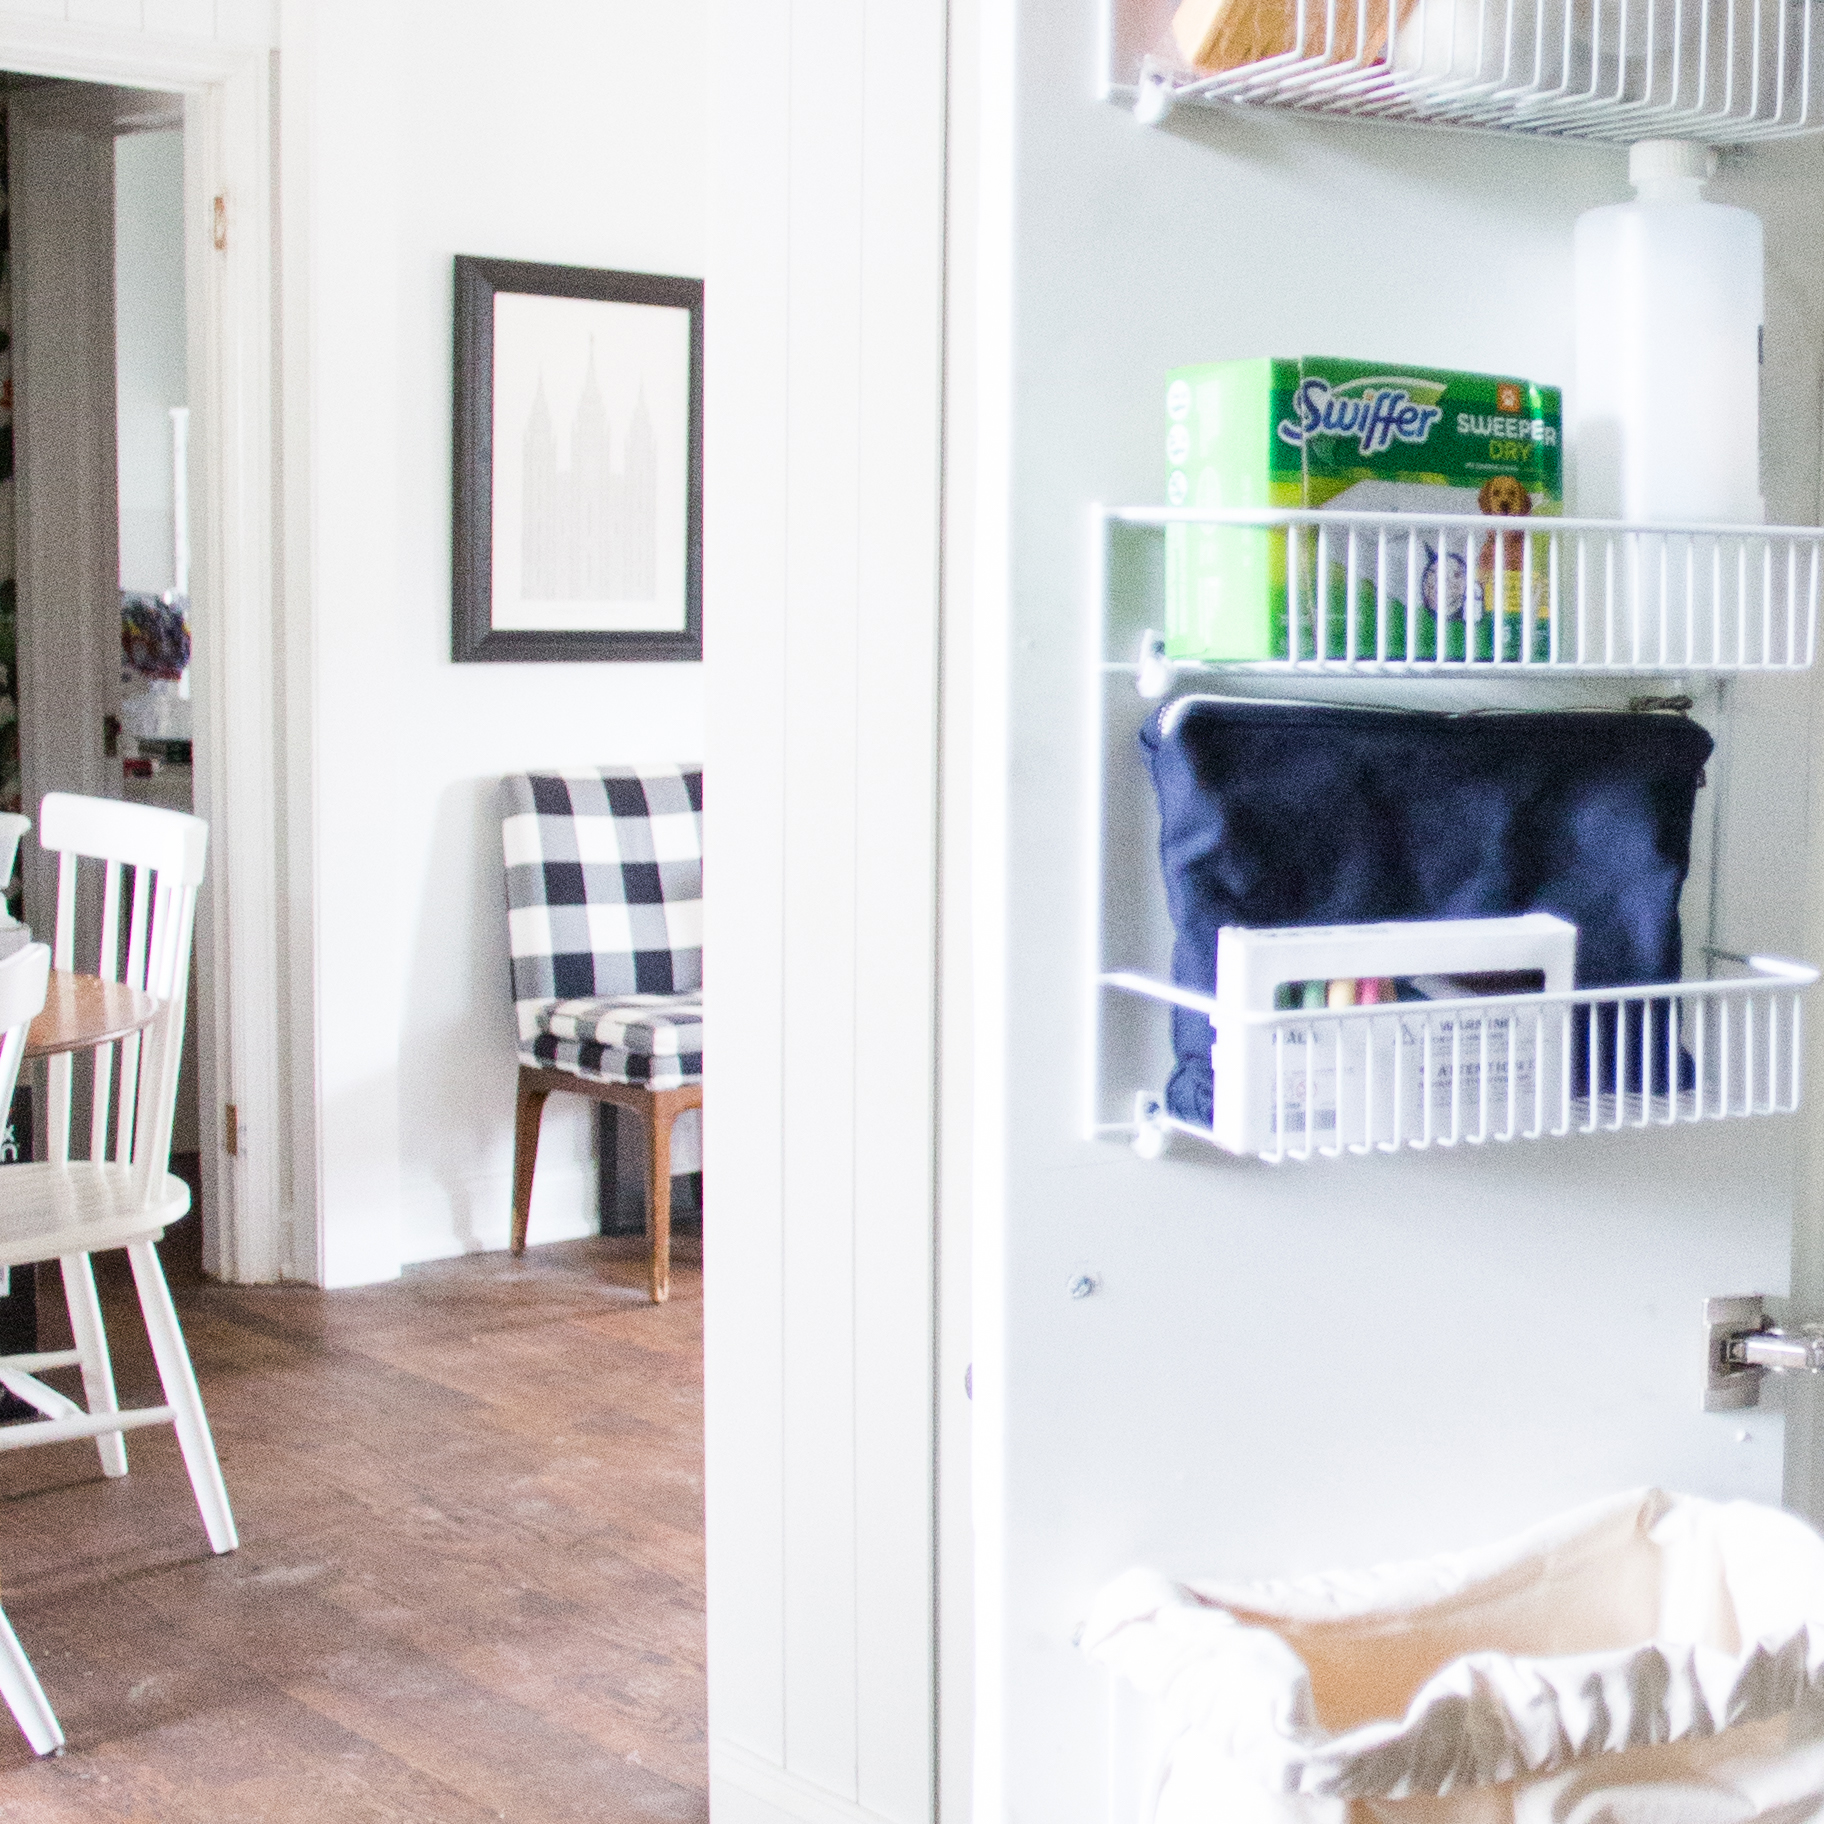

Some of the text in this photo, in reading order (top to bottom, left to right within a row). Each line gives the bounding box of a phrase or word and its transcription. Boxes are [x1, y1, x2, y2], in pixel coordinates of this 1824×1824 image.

[1277, 376, 1443, 455] Swiffer
[1456, 412, 1559, 448] SWEEPER
[1489, 439, 1532, 462] DRY
